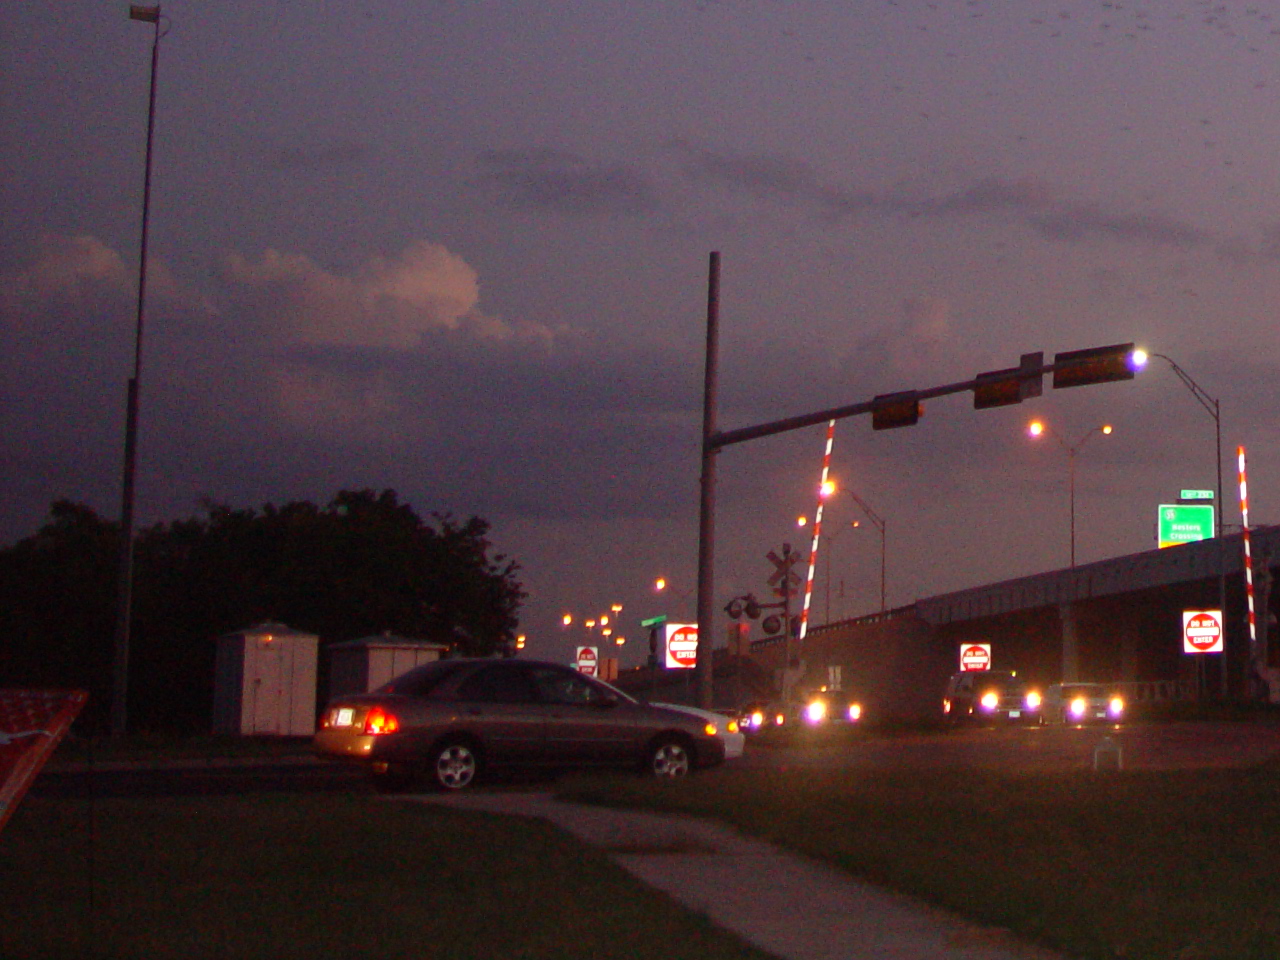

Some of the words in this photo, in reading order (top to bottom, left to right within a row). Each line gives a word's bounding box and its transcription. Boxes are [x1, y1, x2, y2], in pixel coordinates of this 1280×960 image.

[1190, 620, 1200, 628] DO
[674, 633, 685, 641] DO
[686, 633, 698, 641] NO
[1193, 636, 1214, 644] ENTER
